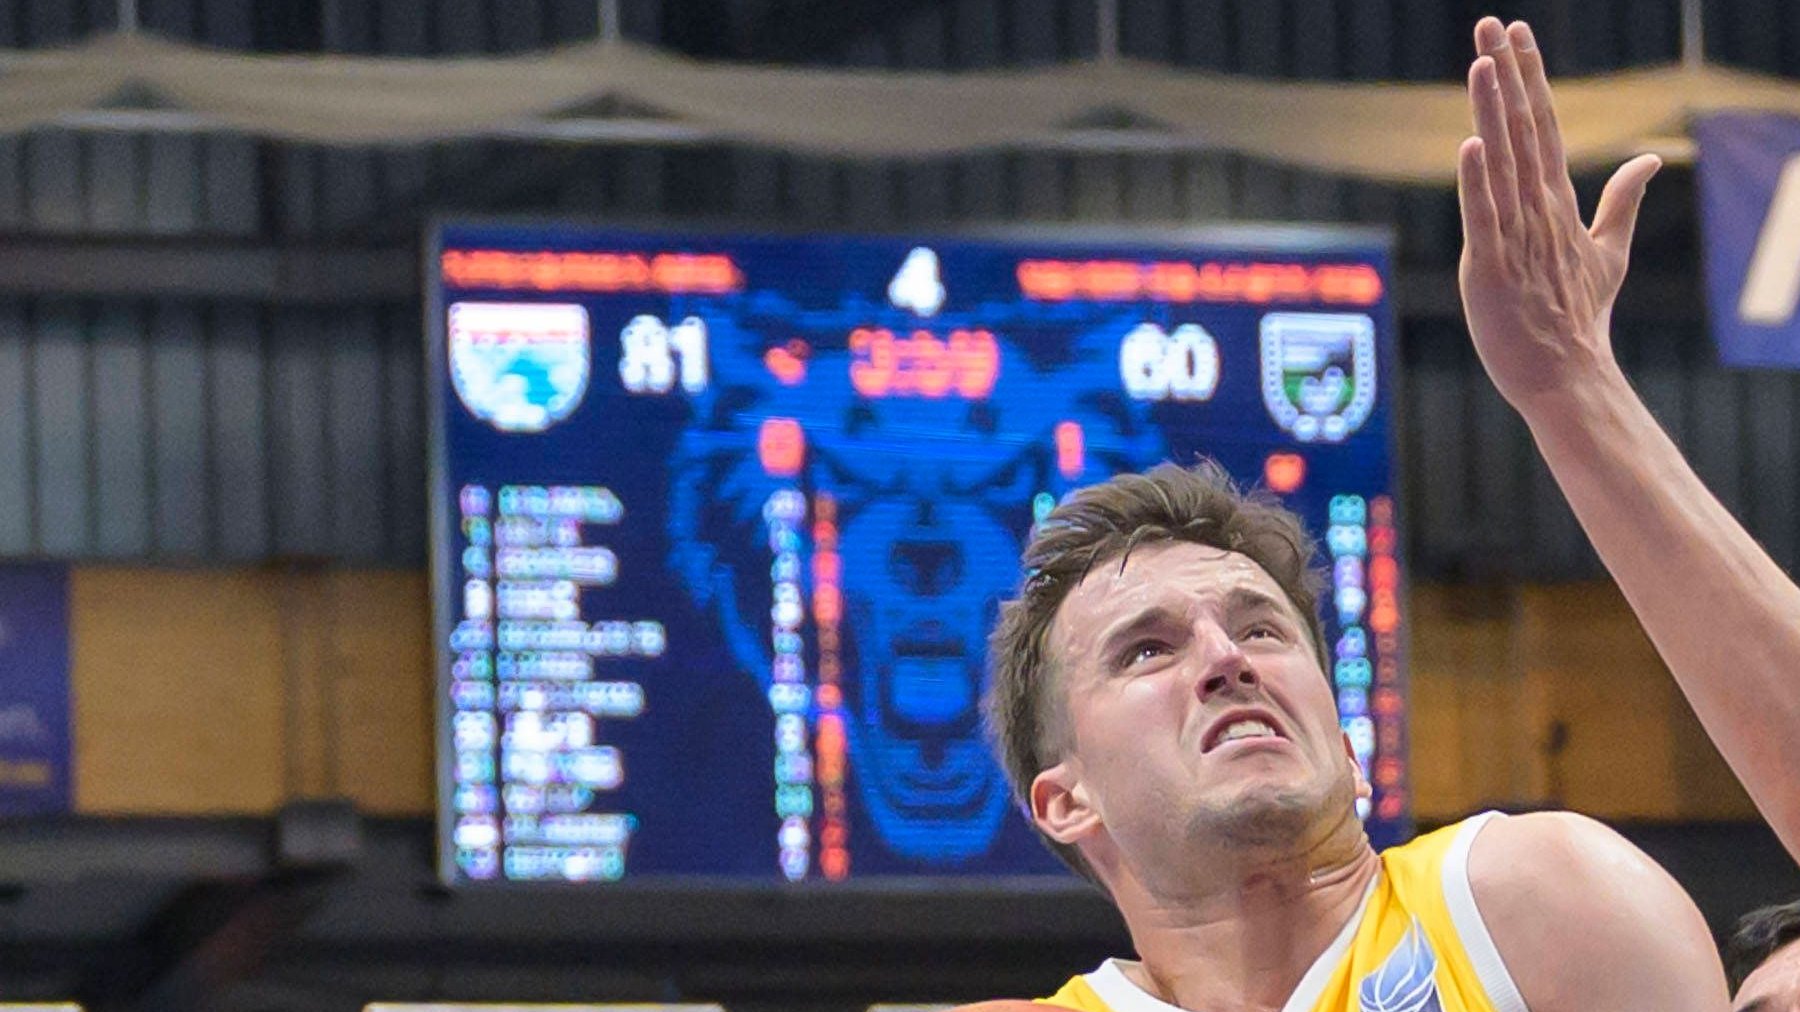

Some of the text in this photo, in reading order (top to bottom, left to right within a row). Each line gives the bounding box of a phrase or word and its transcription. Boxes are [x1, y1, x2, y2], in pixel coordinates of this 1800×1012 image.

[888, 246, 946, 317] 4
[619, 314, 708, 395] 81
[1120, 323, 1219, 401] 60
